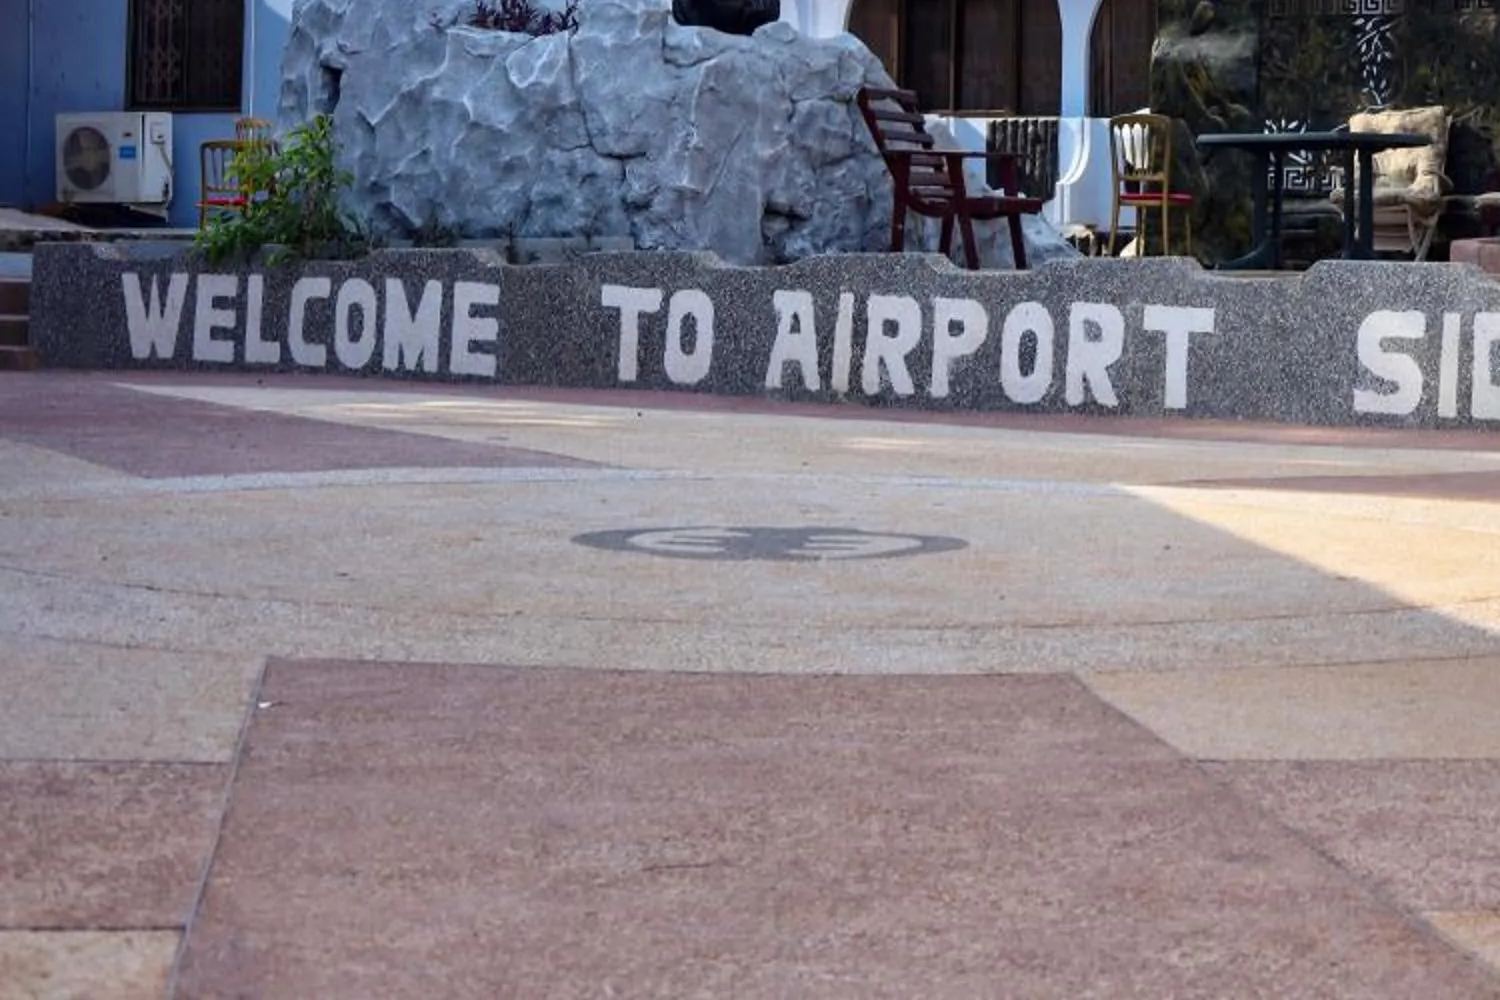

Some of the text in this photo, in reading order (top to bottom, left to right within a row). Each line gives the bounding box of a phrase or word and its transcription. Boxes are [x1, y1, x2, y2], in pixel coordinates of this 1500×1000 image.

[122, 272, 500, 377] WELCOME
[601, 284, 714, 385] TO
[765, 288, 1215, 409] AIRPORT
